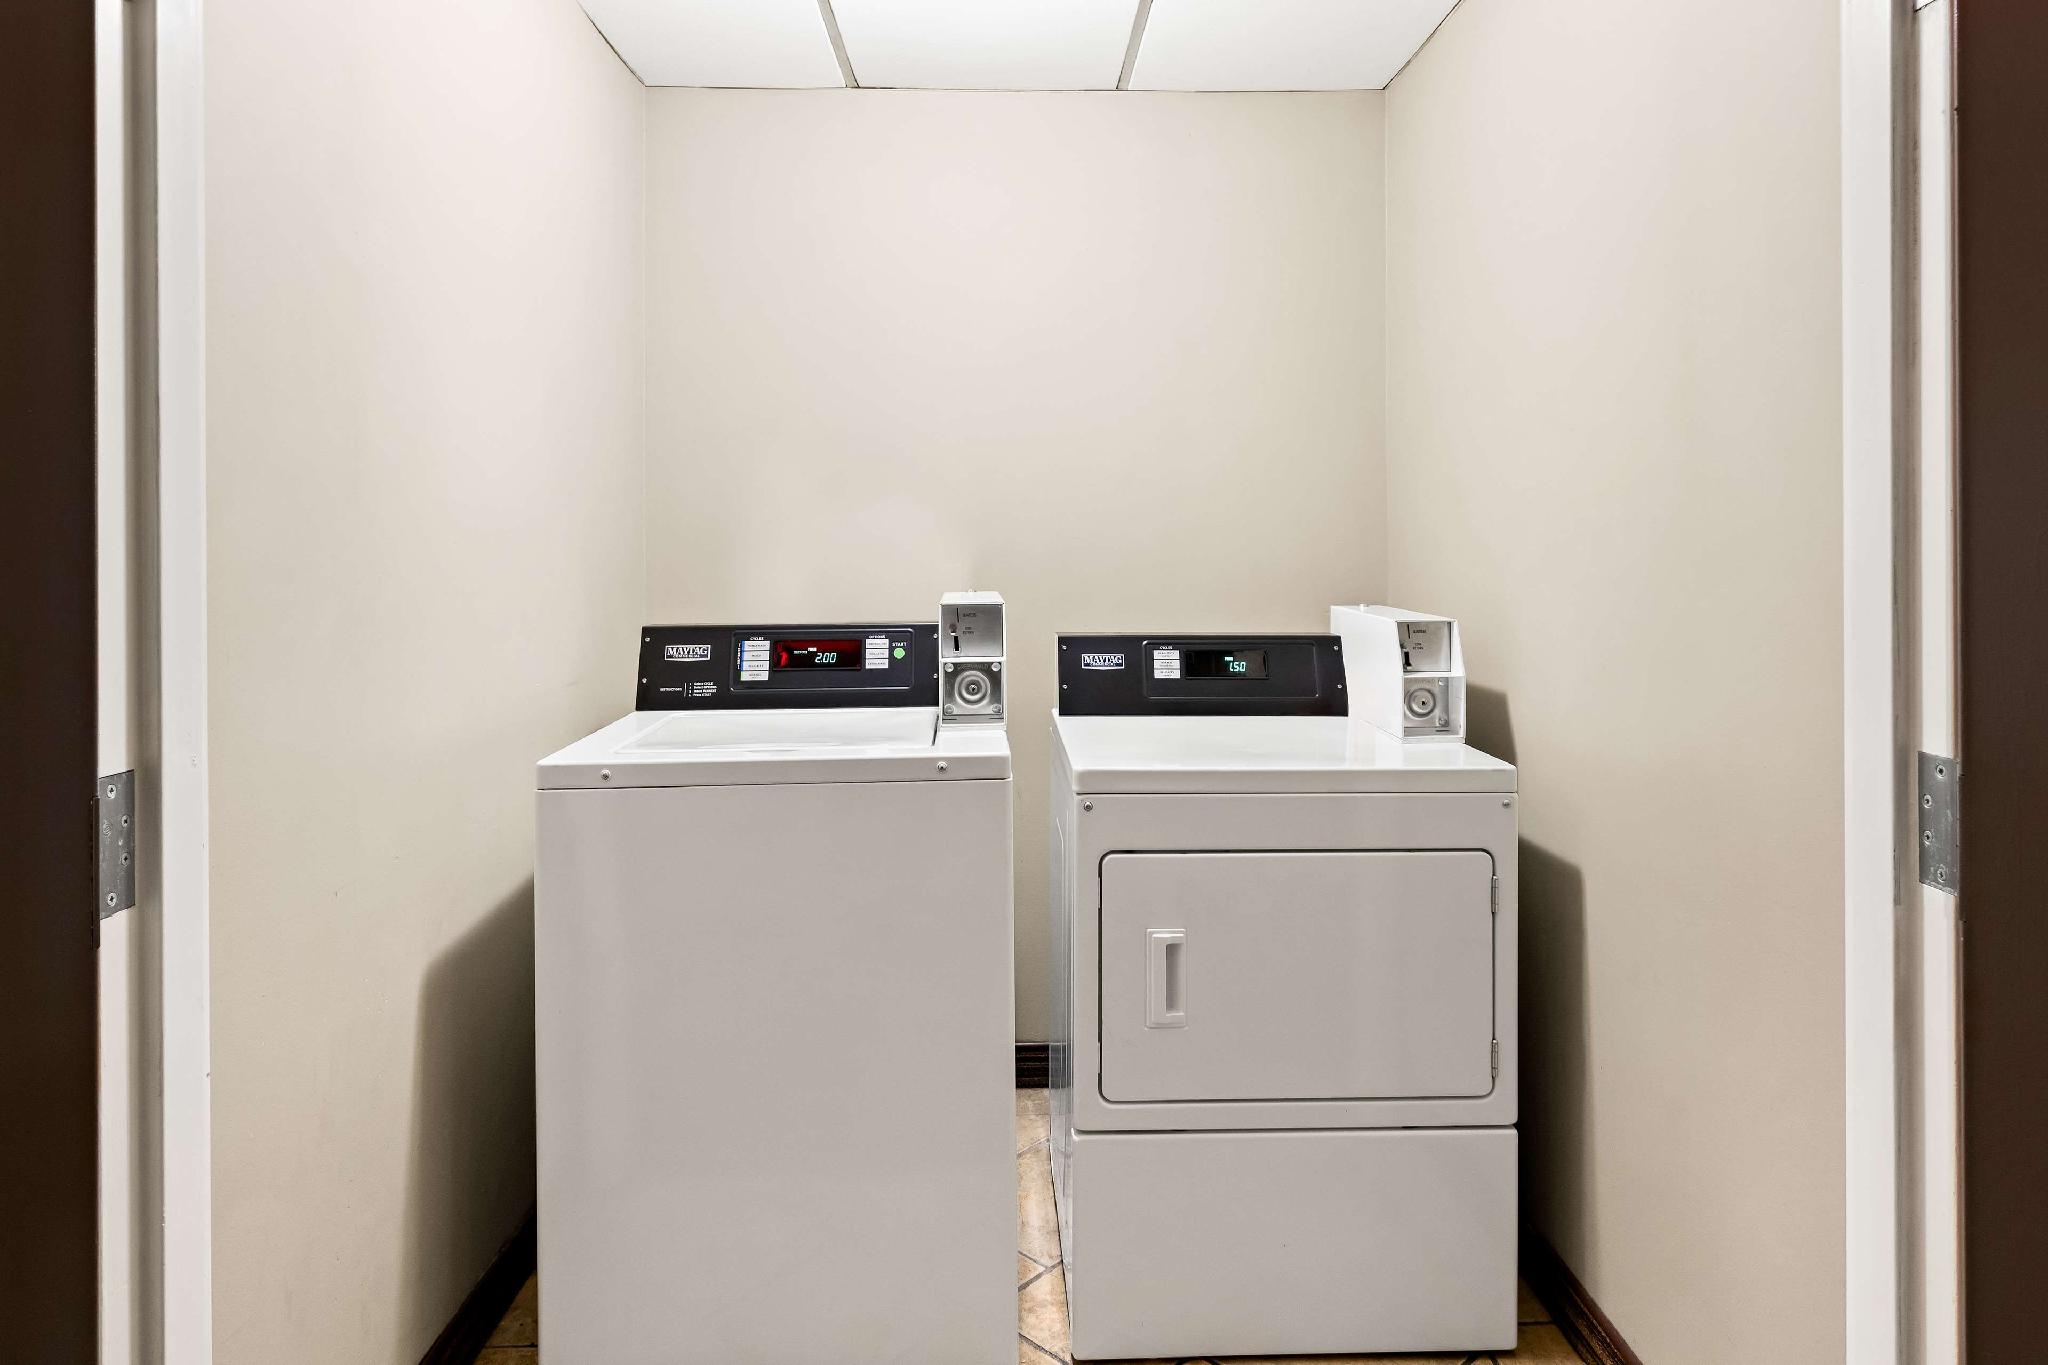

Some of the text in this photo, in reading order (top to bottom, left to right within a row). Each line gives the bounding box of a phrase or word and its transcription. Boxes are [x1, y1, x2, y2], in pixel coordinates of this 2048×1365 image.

[667, 646, 707, 656] MAYTAG
[815, 652, 837, 663] 2.00
[1083, 655, 1122, 664] MAYTAG
